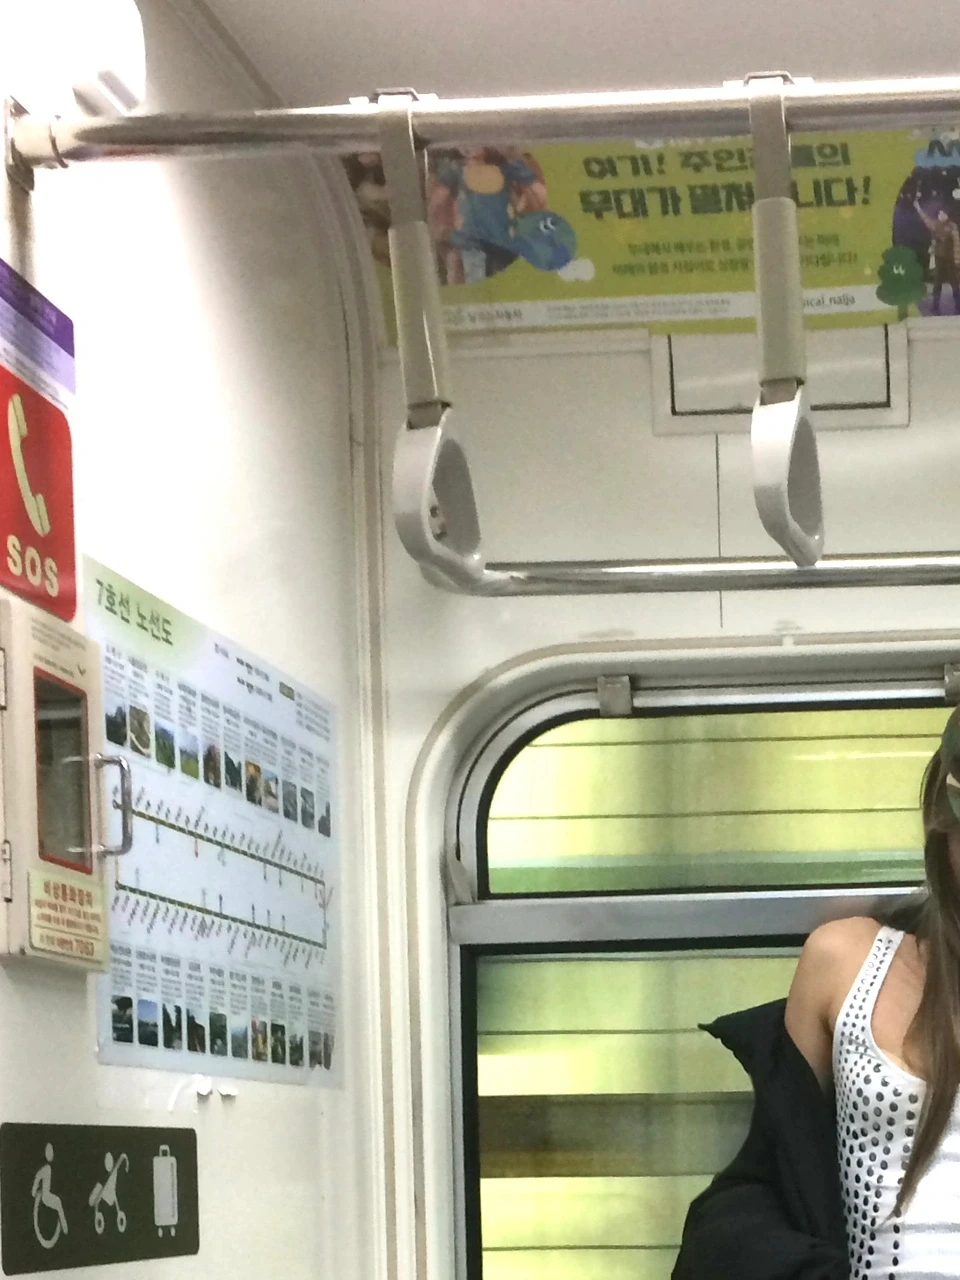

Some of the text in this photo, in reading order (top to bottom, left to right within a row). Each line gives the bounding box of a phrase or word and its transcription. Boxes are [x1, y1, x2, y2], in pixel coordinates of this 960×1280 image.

[582, 142, 851, 180] 여기! 주인들의
[579, 175, 872, 221] 무대가 펼쳐니다!
[7, 534, 60, 598] SOS
[95, 577, 131, 625] 7호선
[135, 602, 174, 647] 노선도
